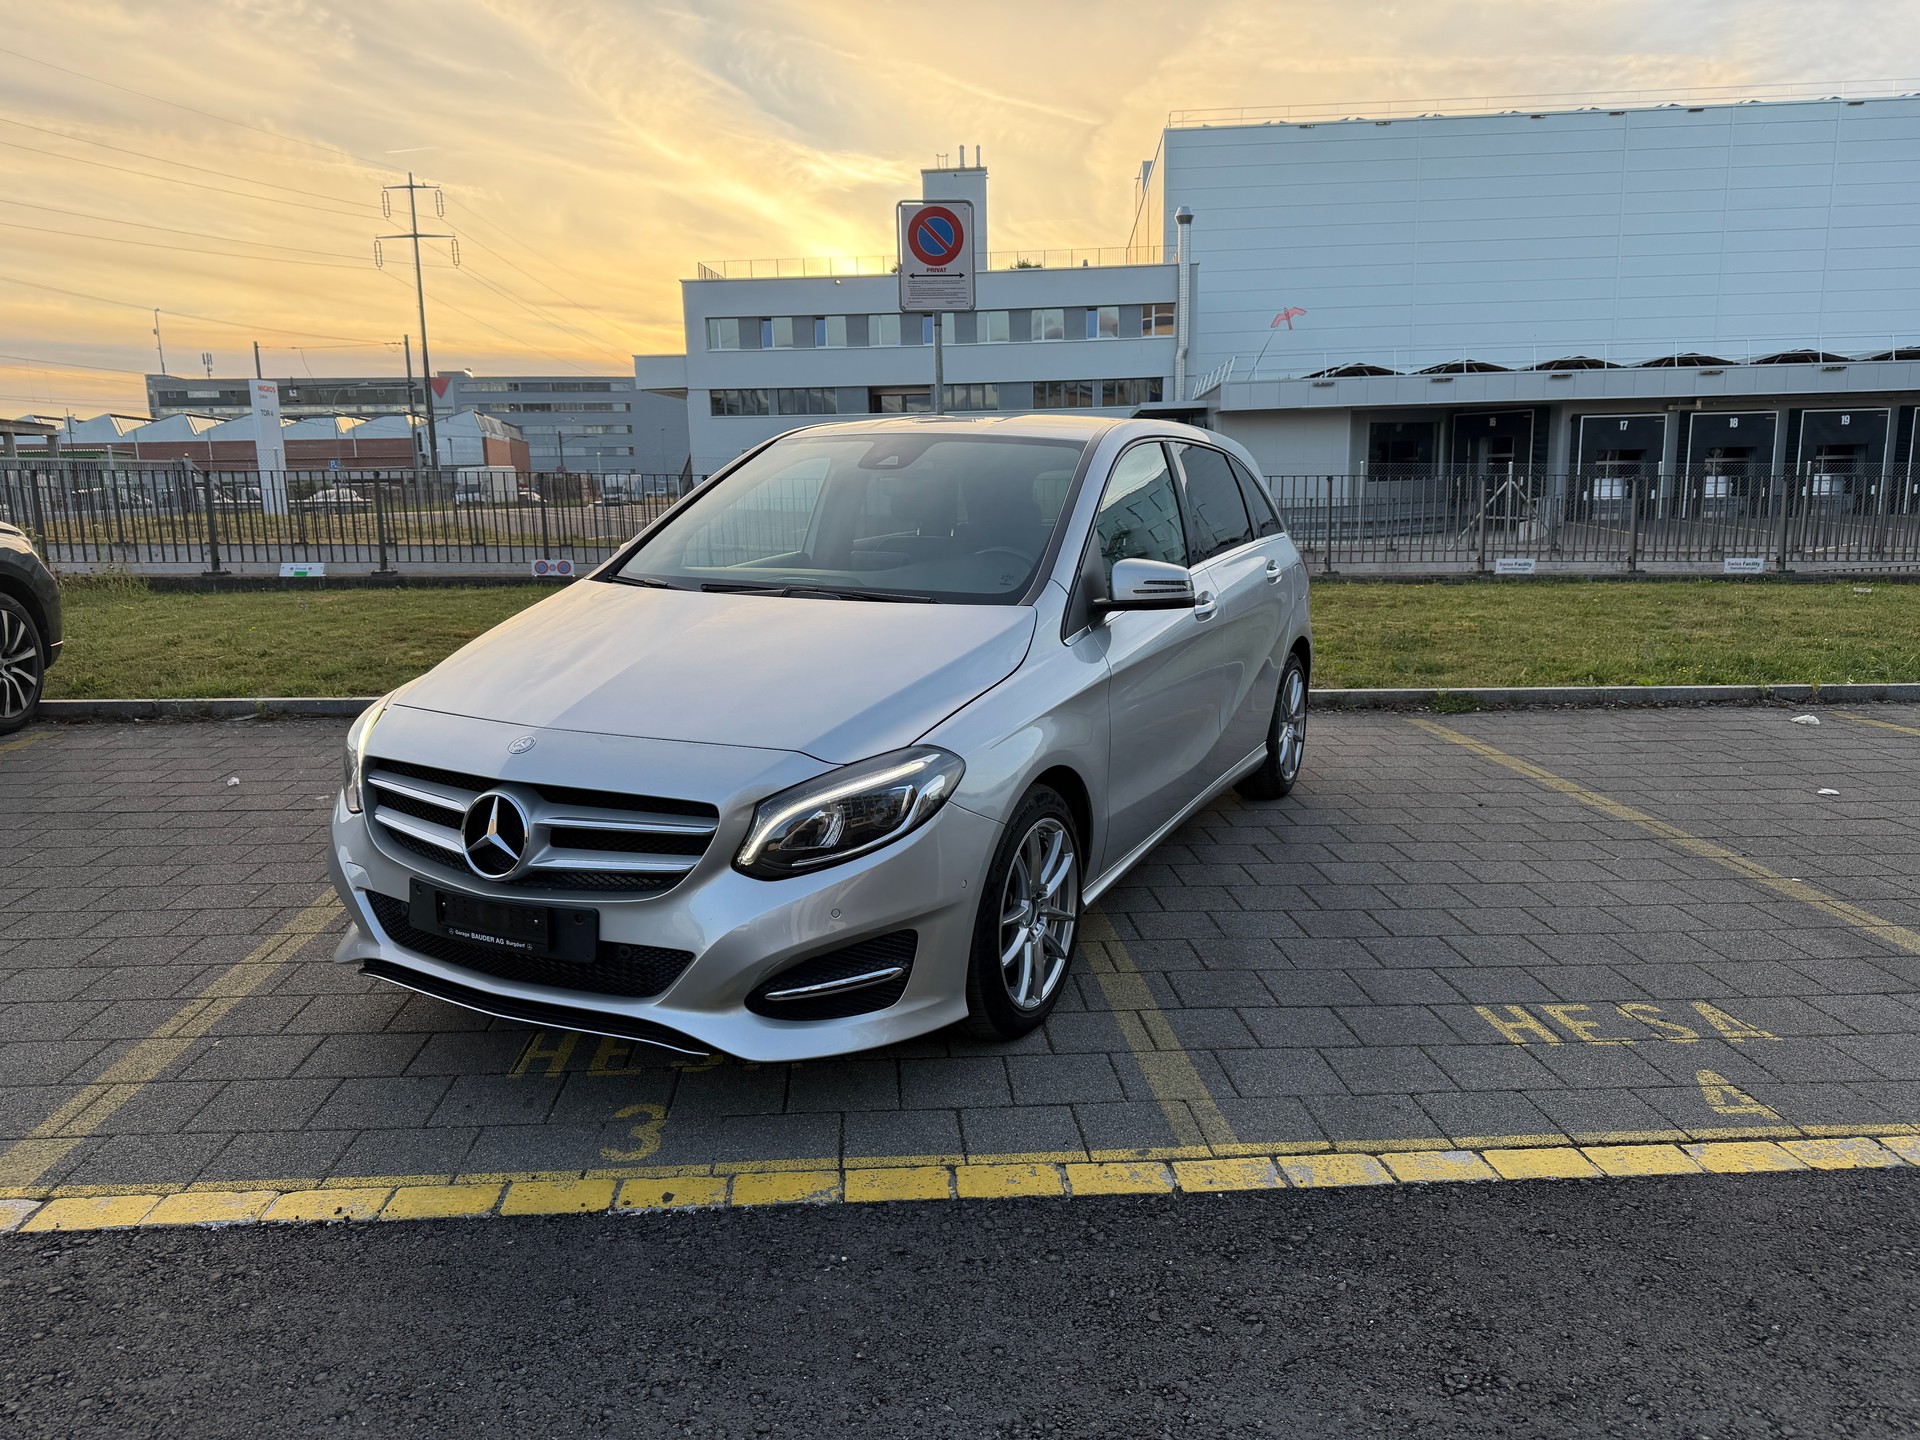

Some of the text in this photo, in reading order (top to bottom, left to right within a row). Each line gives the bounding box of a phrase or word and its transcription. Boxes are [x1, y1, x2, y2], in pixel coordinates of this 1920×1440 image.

[257, 384, 276, 394] MIGROS
[1489, 417, 1497, 427] 16
[1619, 420, 1629, 431] 17
[1729, 417, 1738, 428] 18
[1840, 415, 1850, 426] 19
[454, 929, 526, 949] Garage BAUDER AG Burgdorf
[1473, 1000, 1784, 1047] HESA
[599, 1102, 667, 1163] 3
